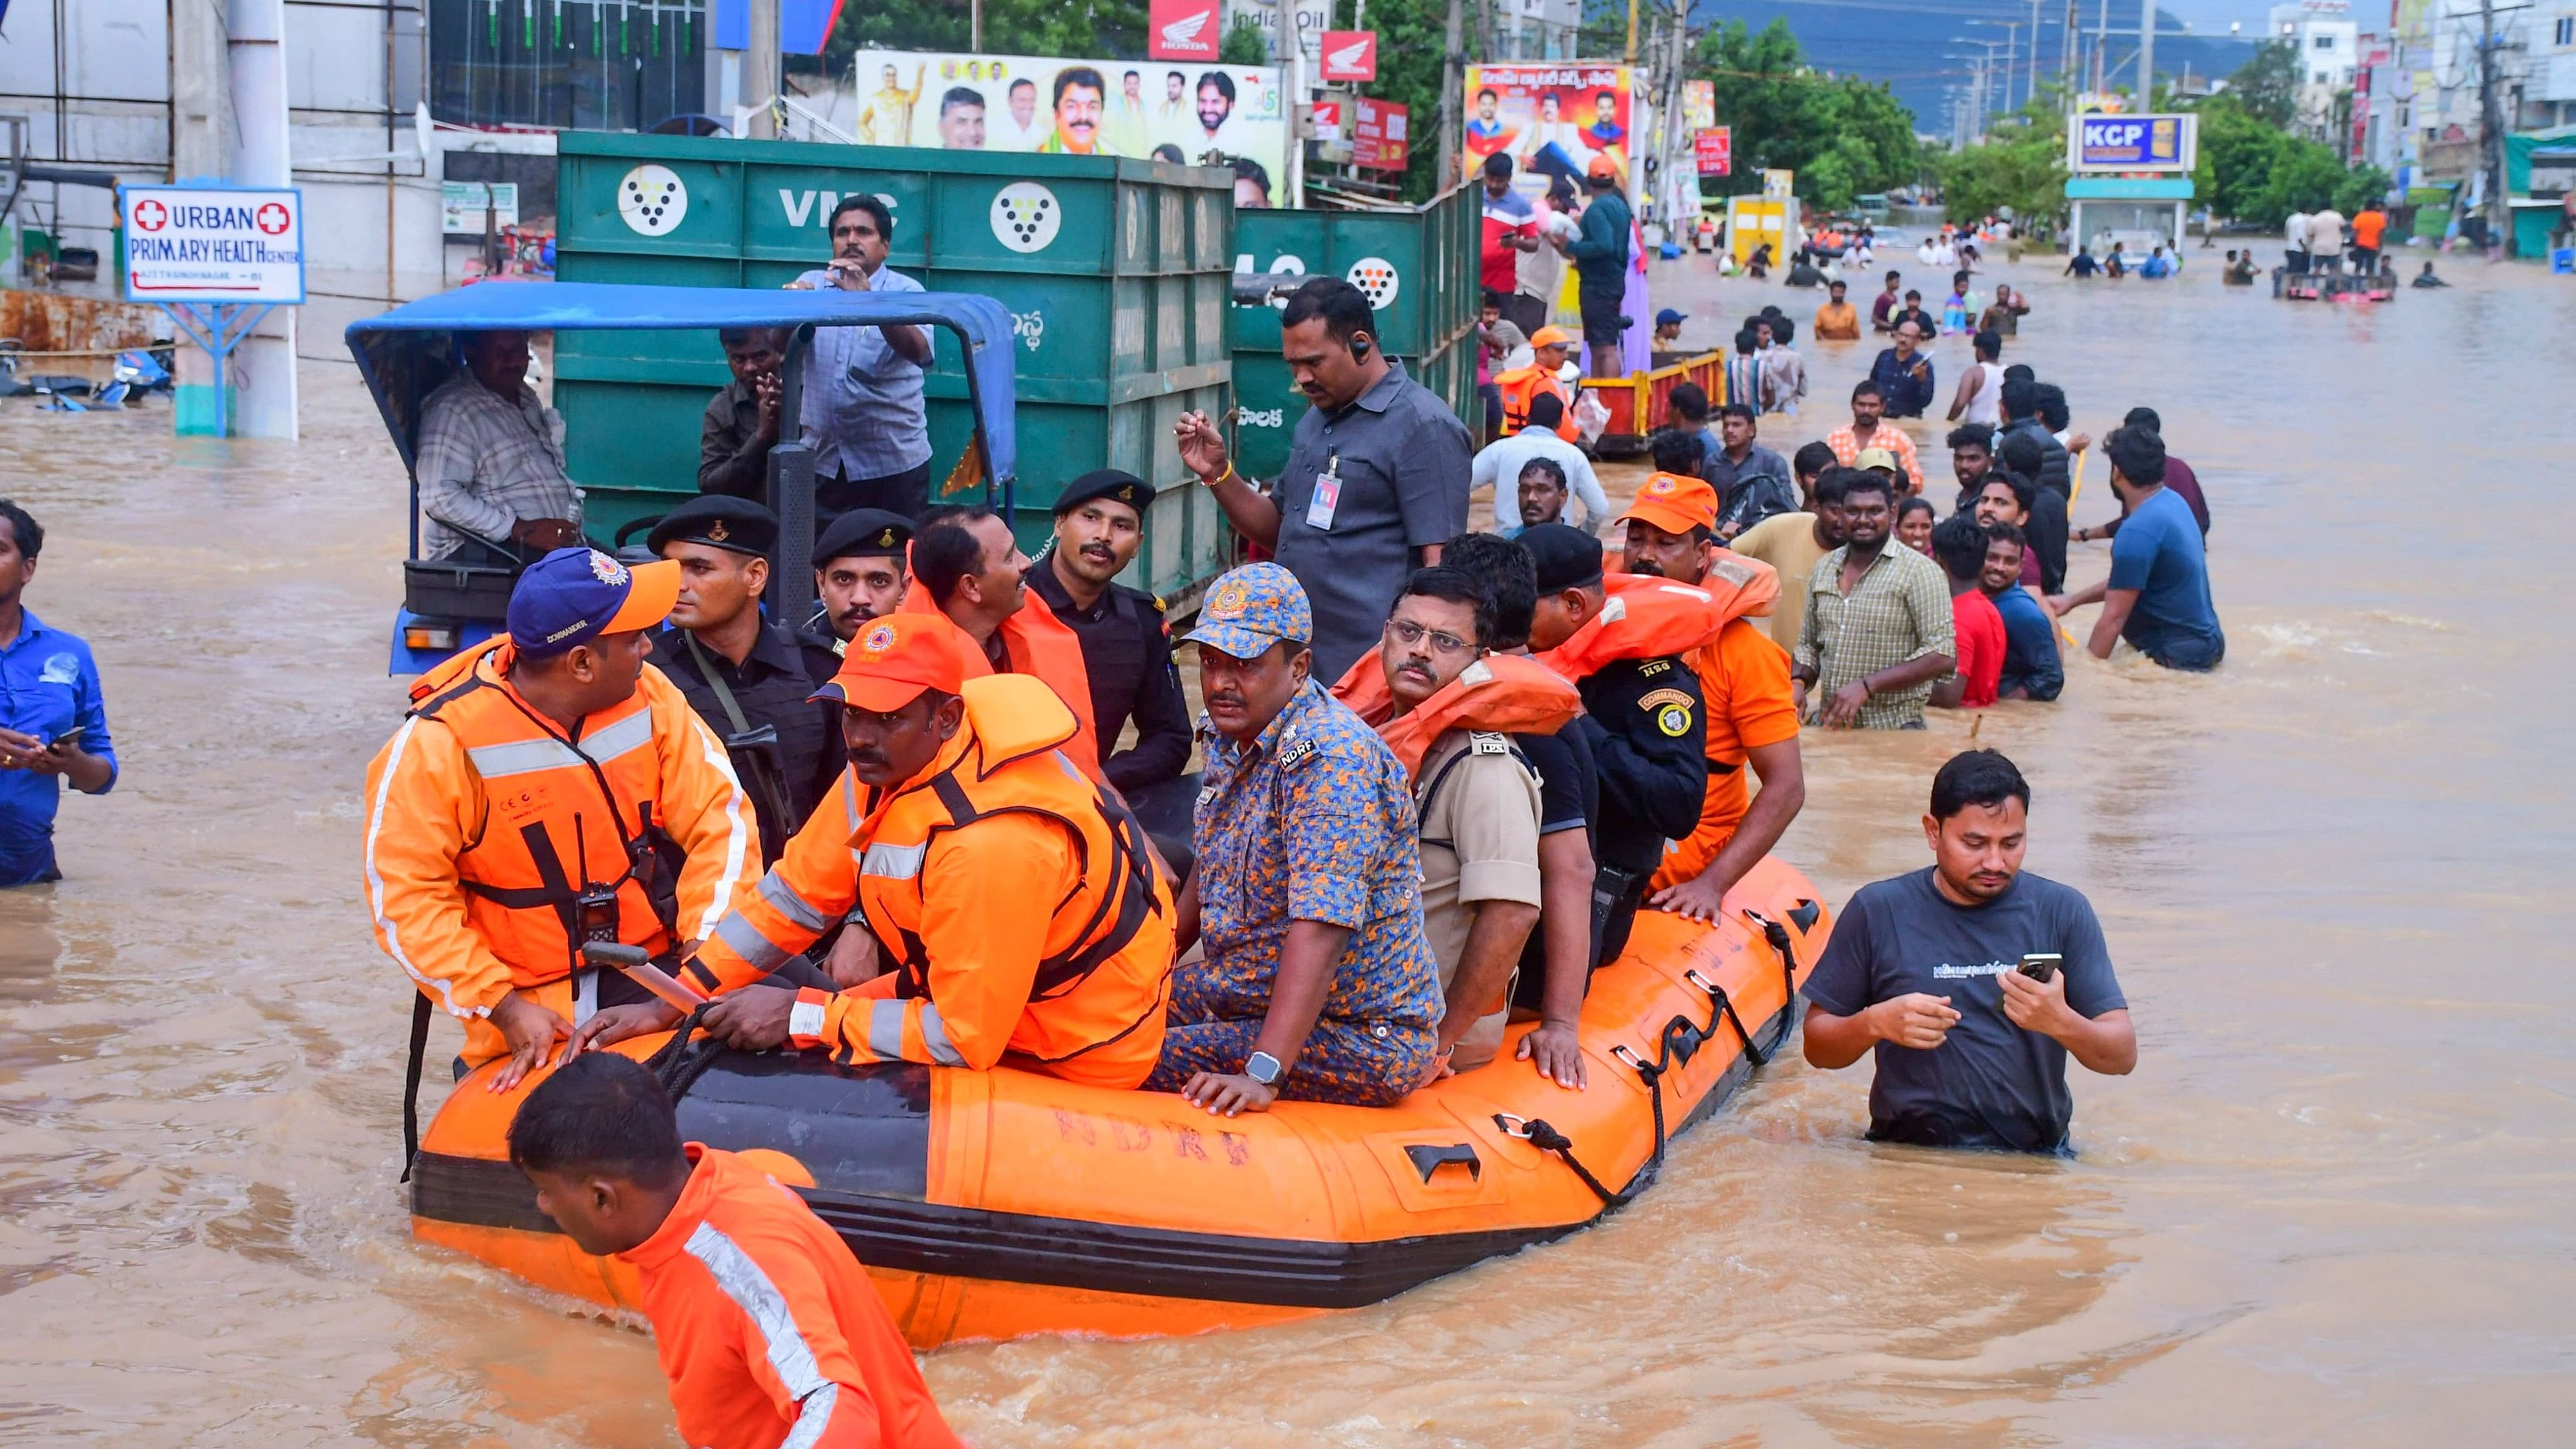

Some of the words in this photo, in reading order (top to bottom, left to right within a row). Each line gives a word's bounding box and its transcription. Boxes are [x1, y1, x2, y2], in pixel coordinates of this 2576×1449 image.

[1162, 41, 1208, 51] HONDA
[2084, 124, 2144, 146] KCP
[174, 206, 253, 230] URBAN
[131, 238, 210, 262] PRIMARY
[214, 240, 265, 263] HEALTH
[546, 620, 587, 643] COMMANDER
[1643, 662, 1671, 677] NSG
[1643, 691, 1690, 706] COMMANDO
[1281, 740, 1313, 766] NDRF
[1482, 743, 1504, 753] IPS
